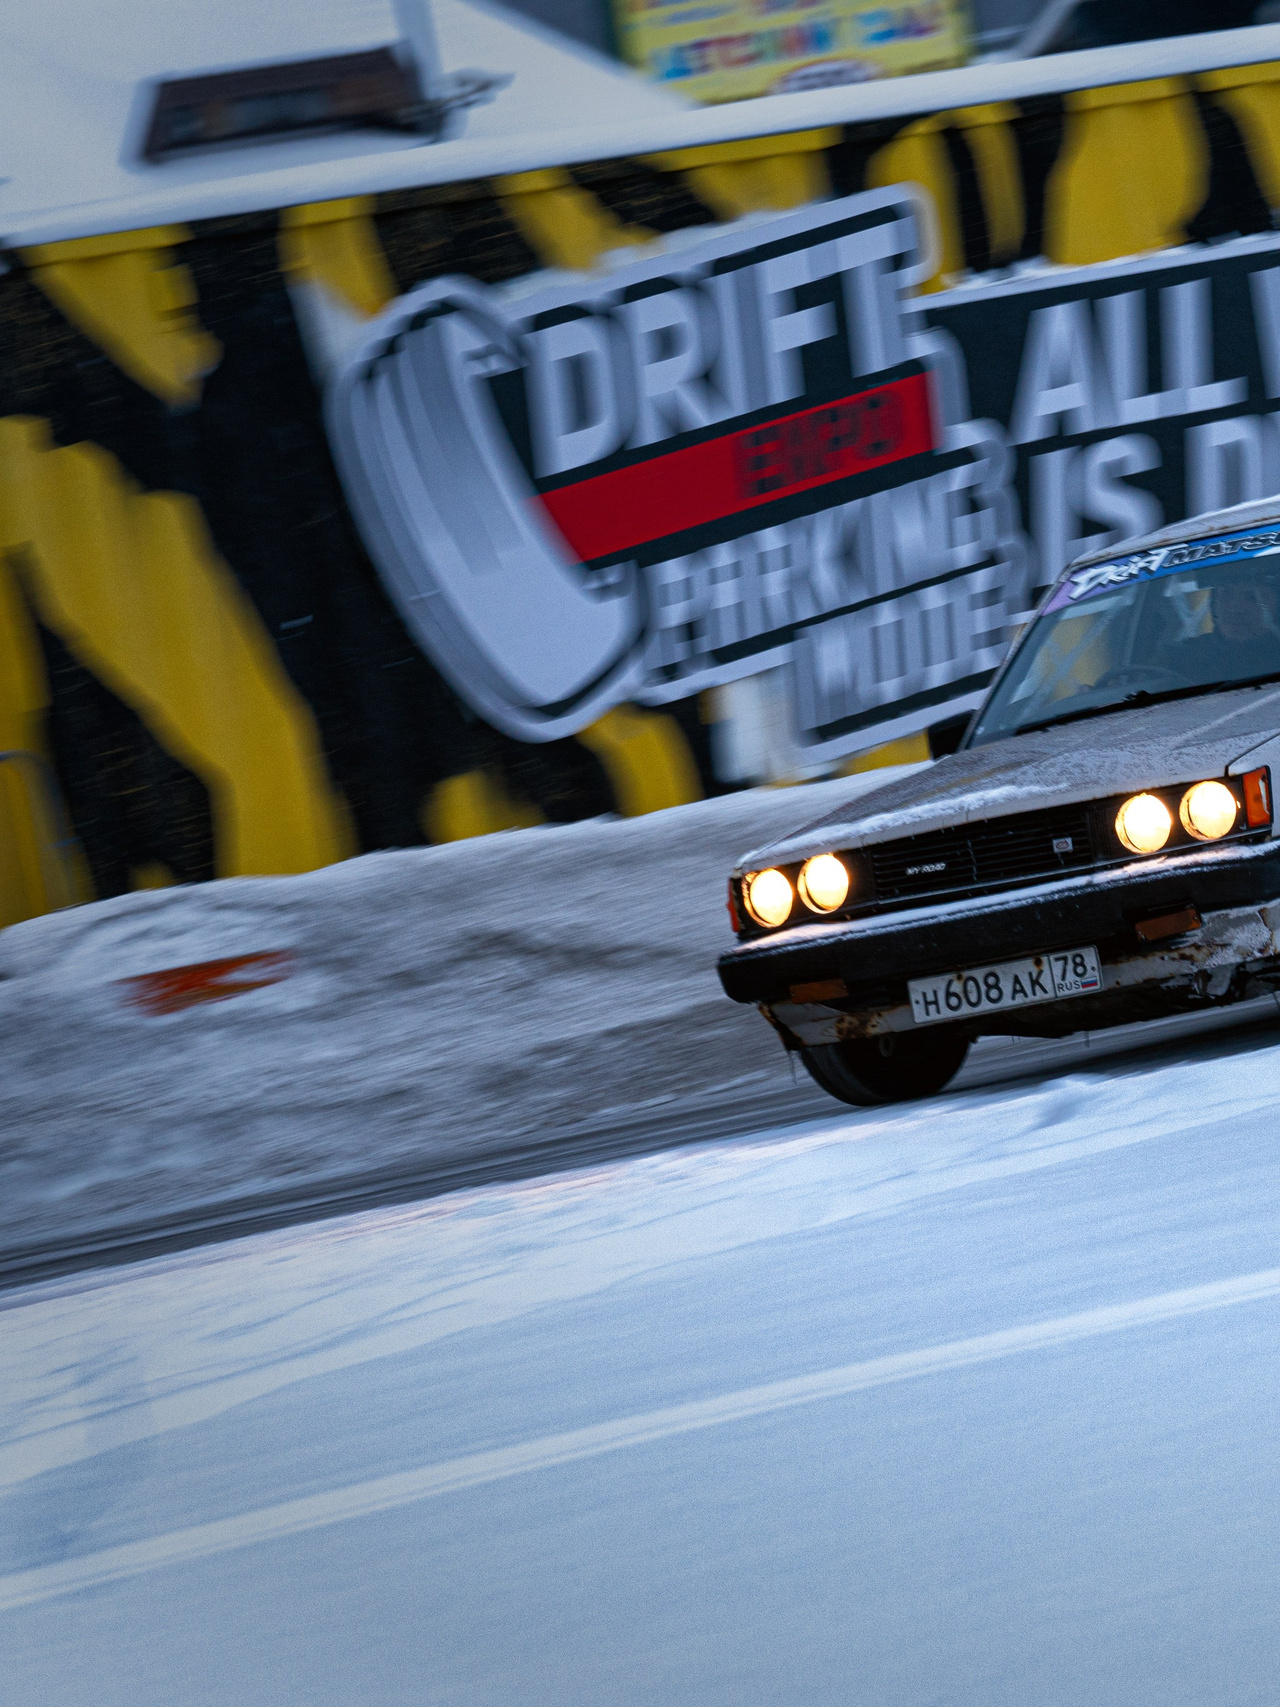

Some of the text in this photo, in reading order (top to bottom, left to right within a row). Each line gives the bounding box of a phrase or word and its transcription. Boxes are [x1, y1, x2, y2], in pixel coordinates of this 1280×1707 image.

[522, 214, 916, 478] DRIFT
[1010, 276, 1248, 446] ALL
[1030, 434, 1165, 590] IS
[1054, 953, 1088, 982] 78
[1056, 979, 1081, 993] RUS
